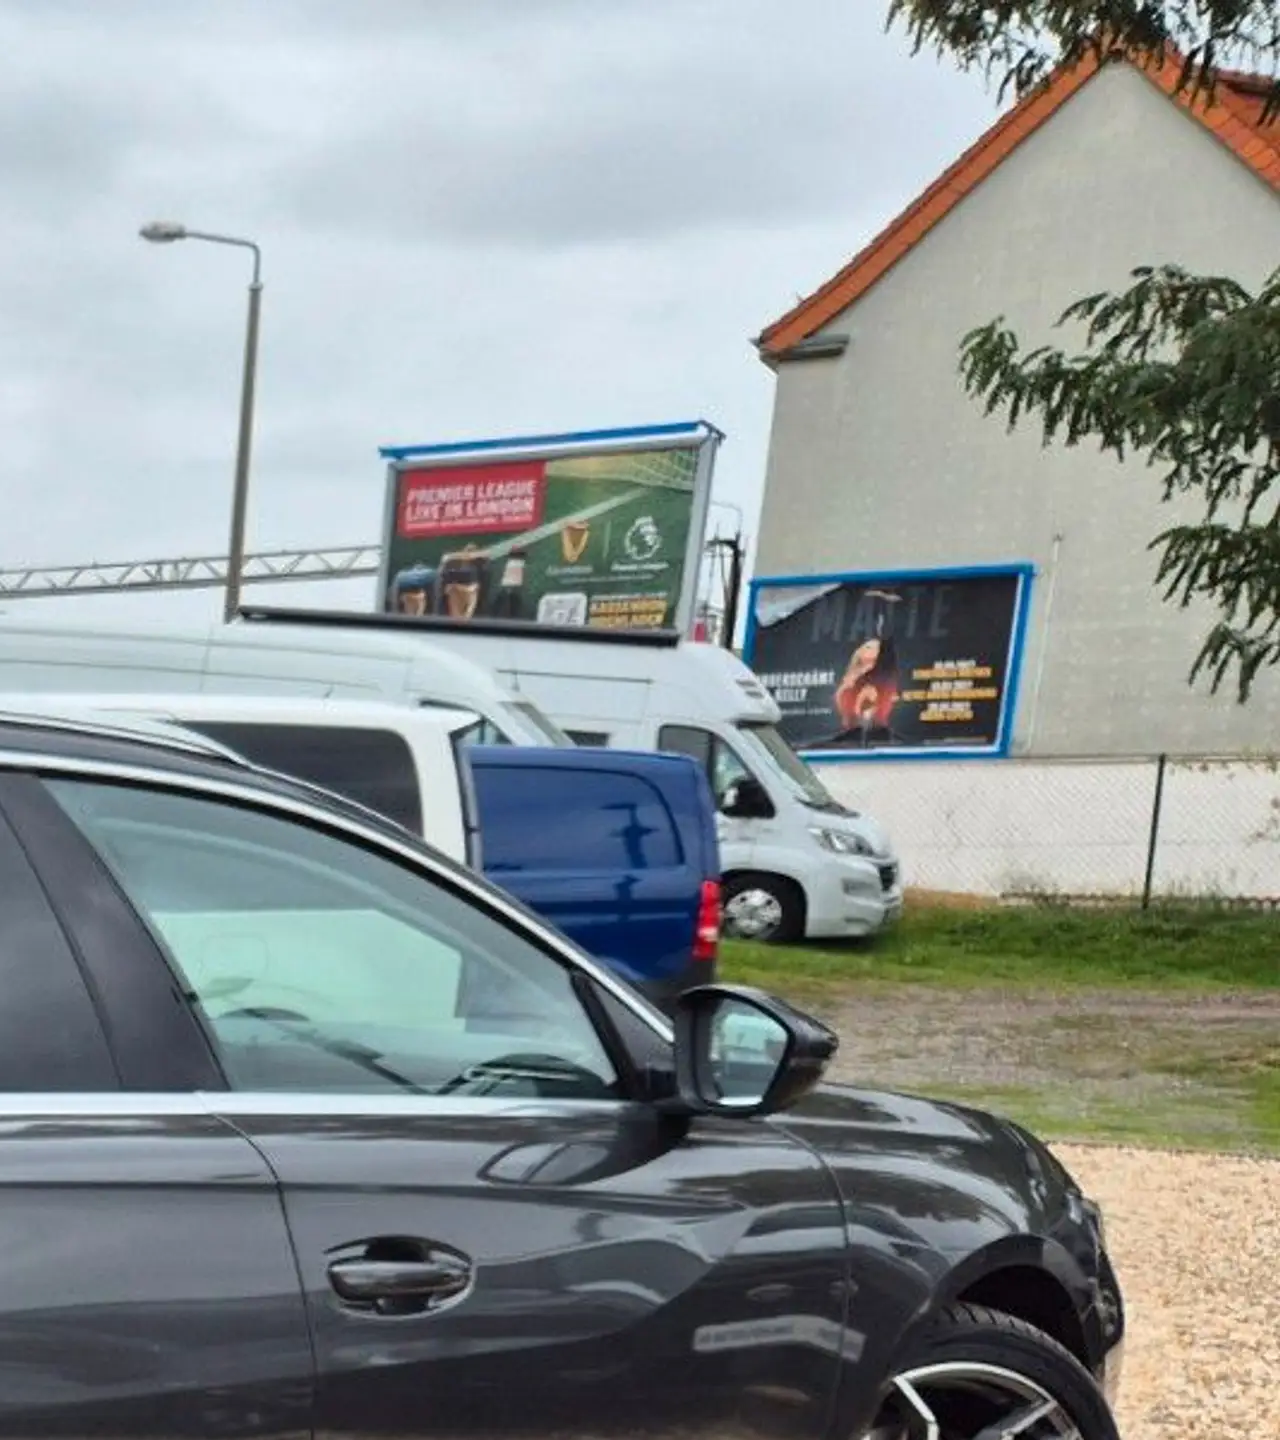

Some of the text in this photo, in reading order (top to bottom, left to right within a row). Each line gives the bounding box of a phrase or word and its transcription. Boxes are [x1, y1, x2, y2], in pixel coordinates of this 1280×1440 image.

[406, 480, 538, 504] PREMIER LEAGUE
[405, 497, 534, 521] LIVE IN LONDON
